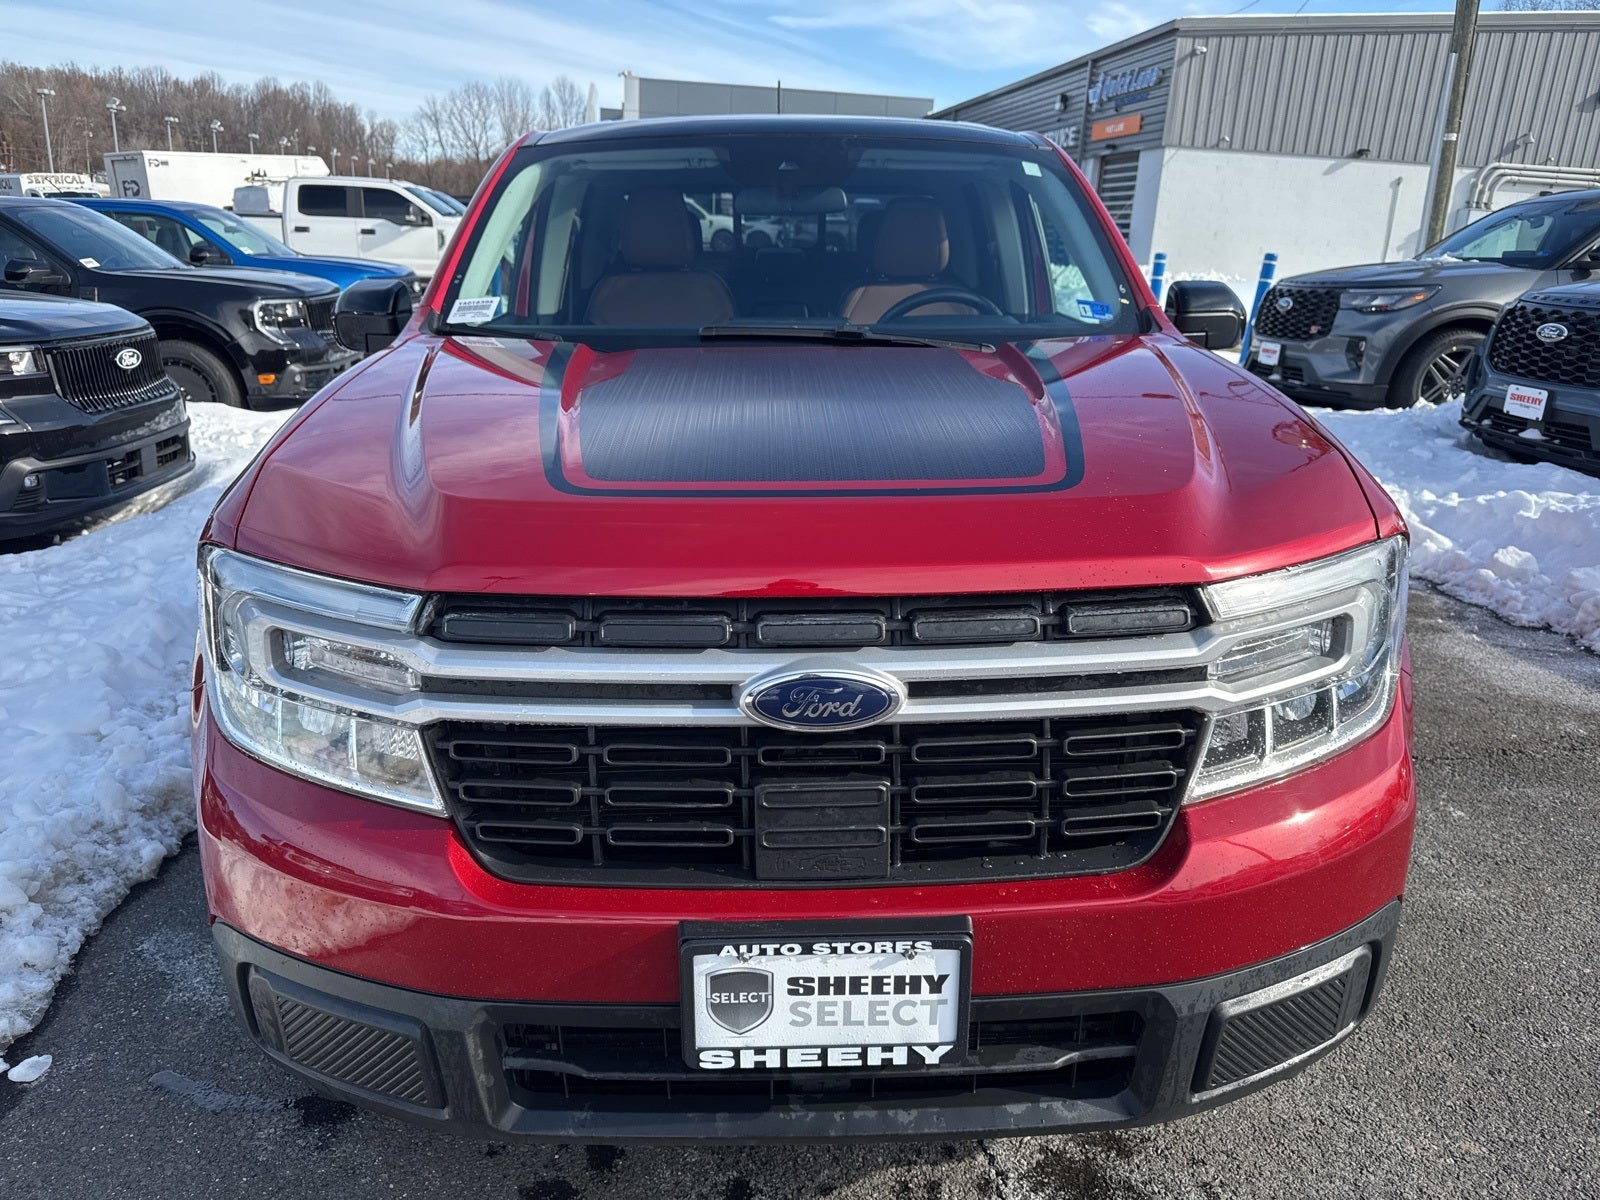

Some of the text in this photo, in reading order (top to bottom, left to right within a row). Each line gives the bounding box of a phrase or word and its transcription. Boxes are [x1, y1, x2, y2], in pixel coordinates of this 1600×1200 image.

[1510, 392, 1544, 406] SHEEHY
[782, 686, 862, 718] Ford
[718, 940, 934, 957] AUTO STORES
[787, 973, 951, 997] SHEEHY
[710, 992, 770, 1004] SELECT
[788, 999, 949, 1028] SELECT
[698, 1045, 955, 1070] SHEEHY
